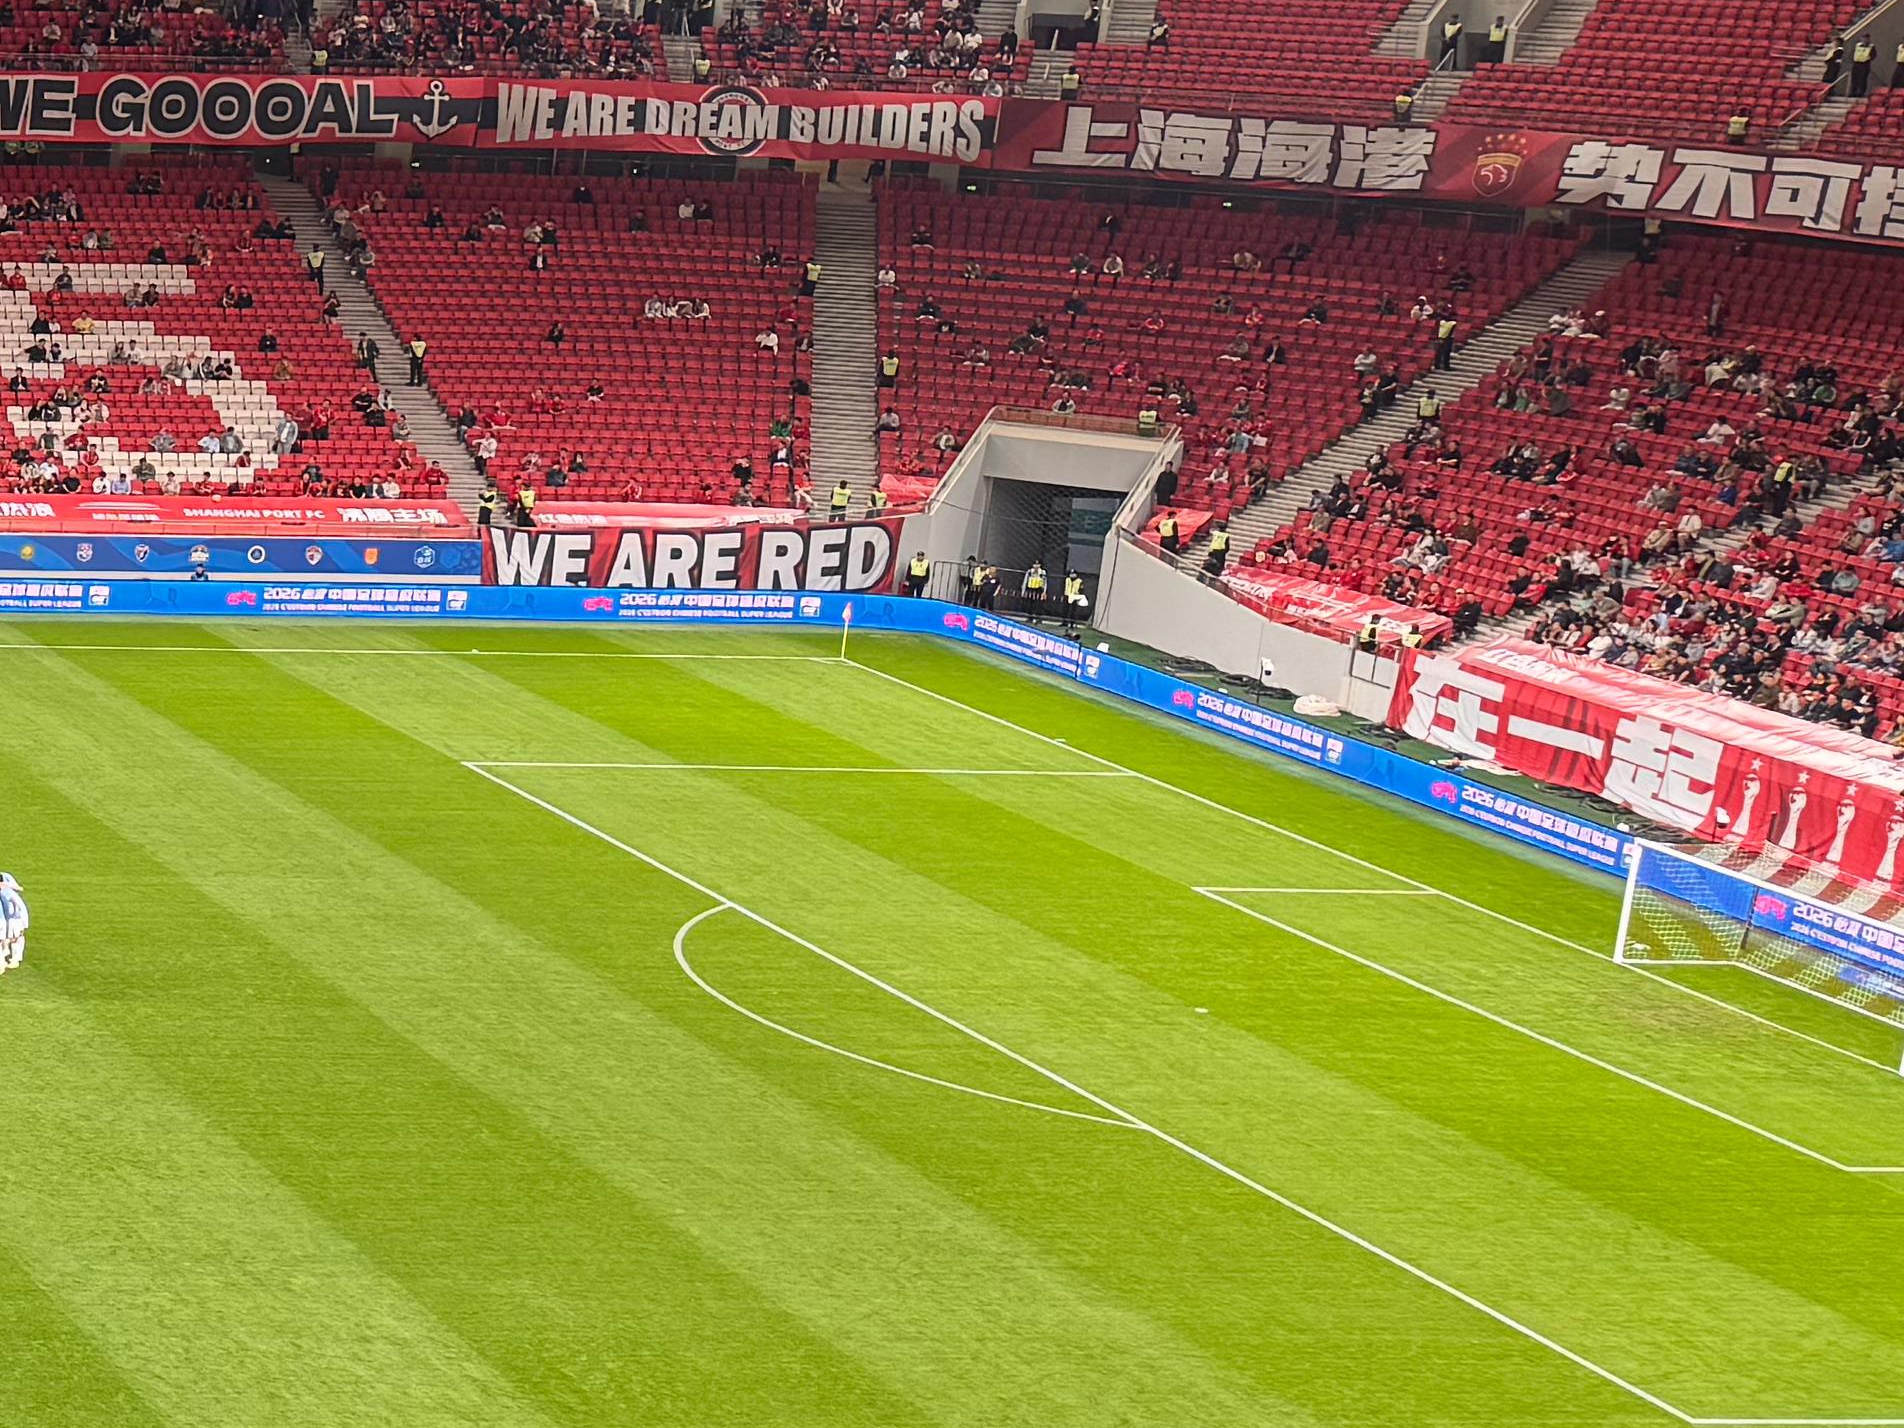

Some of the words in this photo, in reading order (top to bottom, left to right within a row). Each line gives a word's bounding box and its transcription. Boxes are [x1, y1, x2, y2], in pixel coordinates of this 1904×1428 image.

[95, 77, 400, 140] GOOOAL
[496, 82, 556, 143] WE
[562, 90, 635, 138] ARE
[644, 96, 777, 141] DREAM
[789, 99, 985, 162] BUILDERS
[1032, 106, 1436, 190] 上海海港
[183, 508, 260, 518] SHANGHAI
[263, 509, 303, 519] PORT
[306, 509, 325, 519] FC
[490, 527, 591, 588] WE
[607, 531, 741, 590] ARE
[757, 523, 892, 592] RED
[1402, 652, 1725, 832] 在一起
